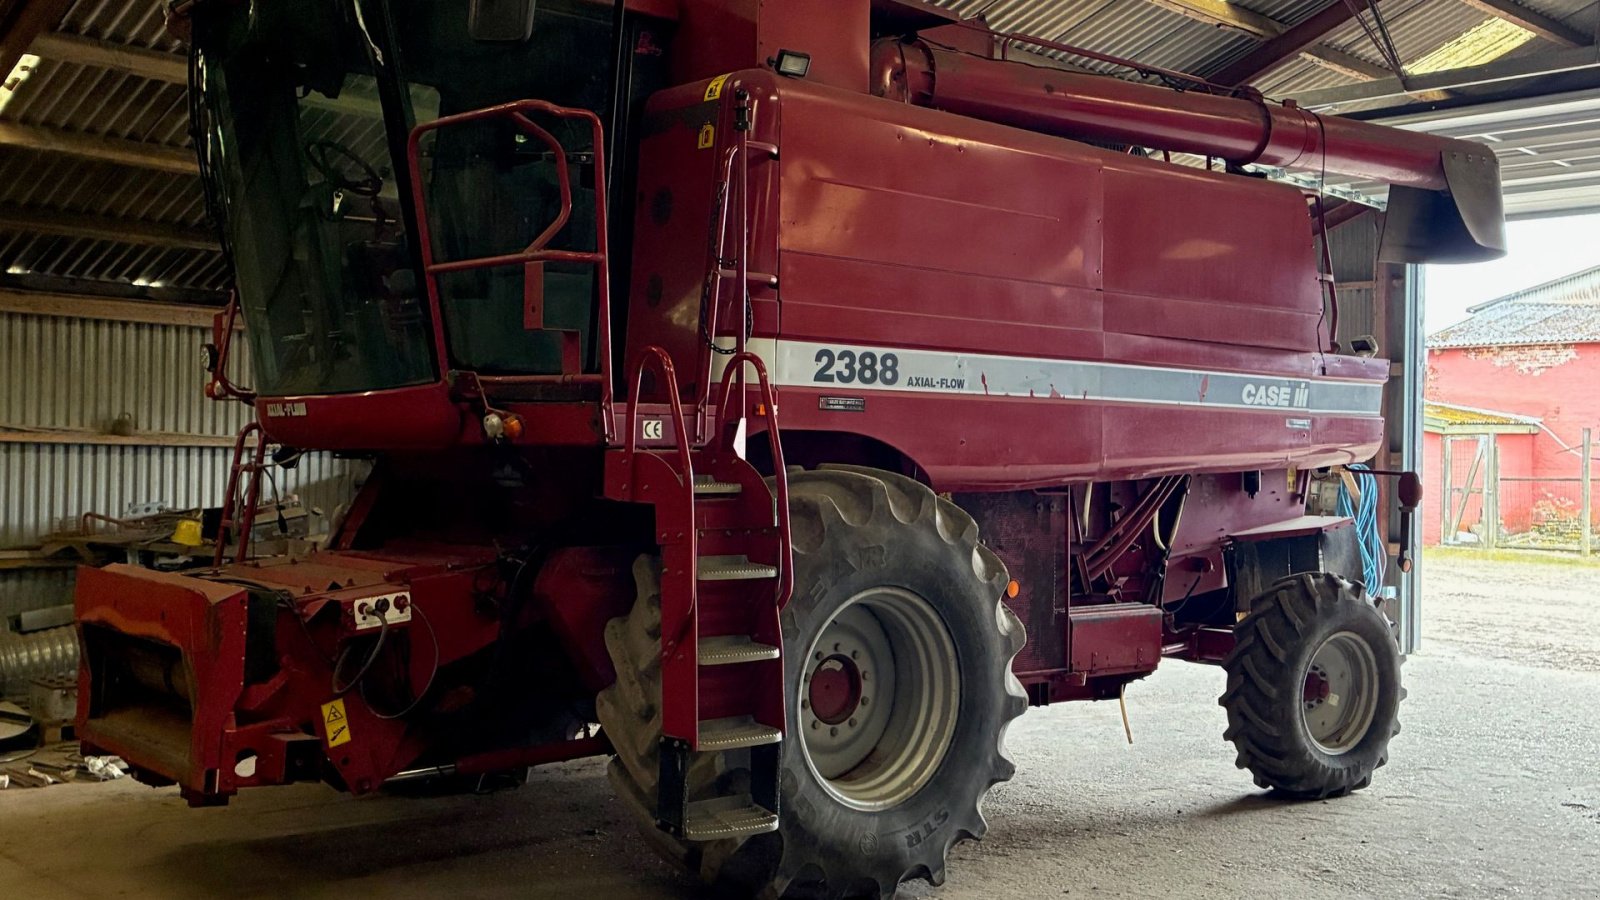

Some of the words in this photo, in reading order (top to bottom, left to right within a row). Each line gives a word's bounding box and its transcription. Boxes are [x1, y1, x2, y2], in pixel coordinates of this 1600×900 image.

[813, 349, 899, 386] 2388
[907, 376, 965, 389] AXIAL-FLOW
[1242, 384, 1291, 406] CASE
[644, 421, 661, 438] CE
